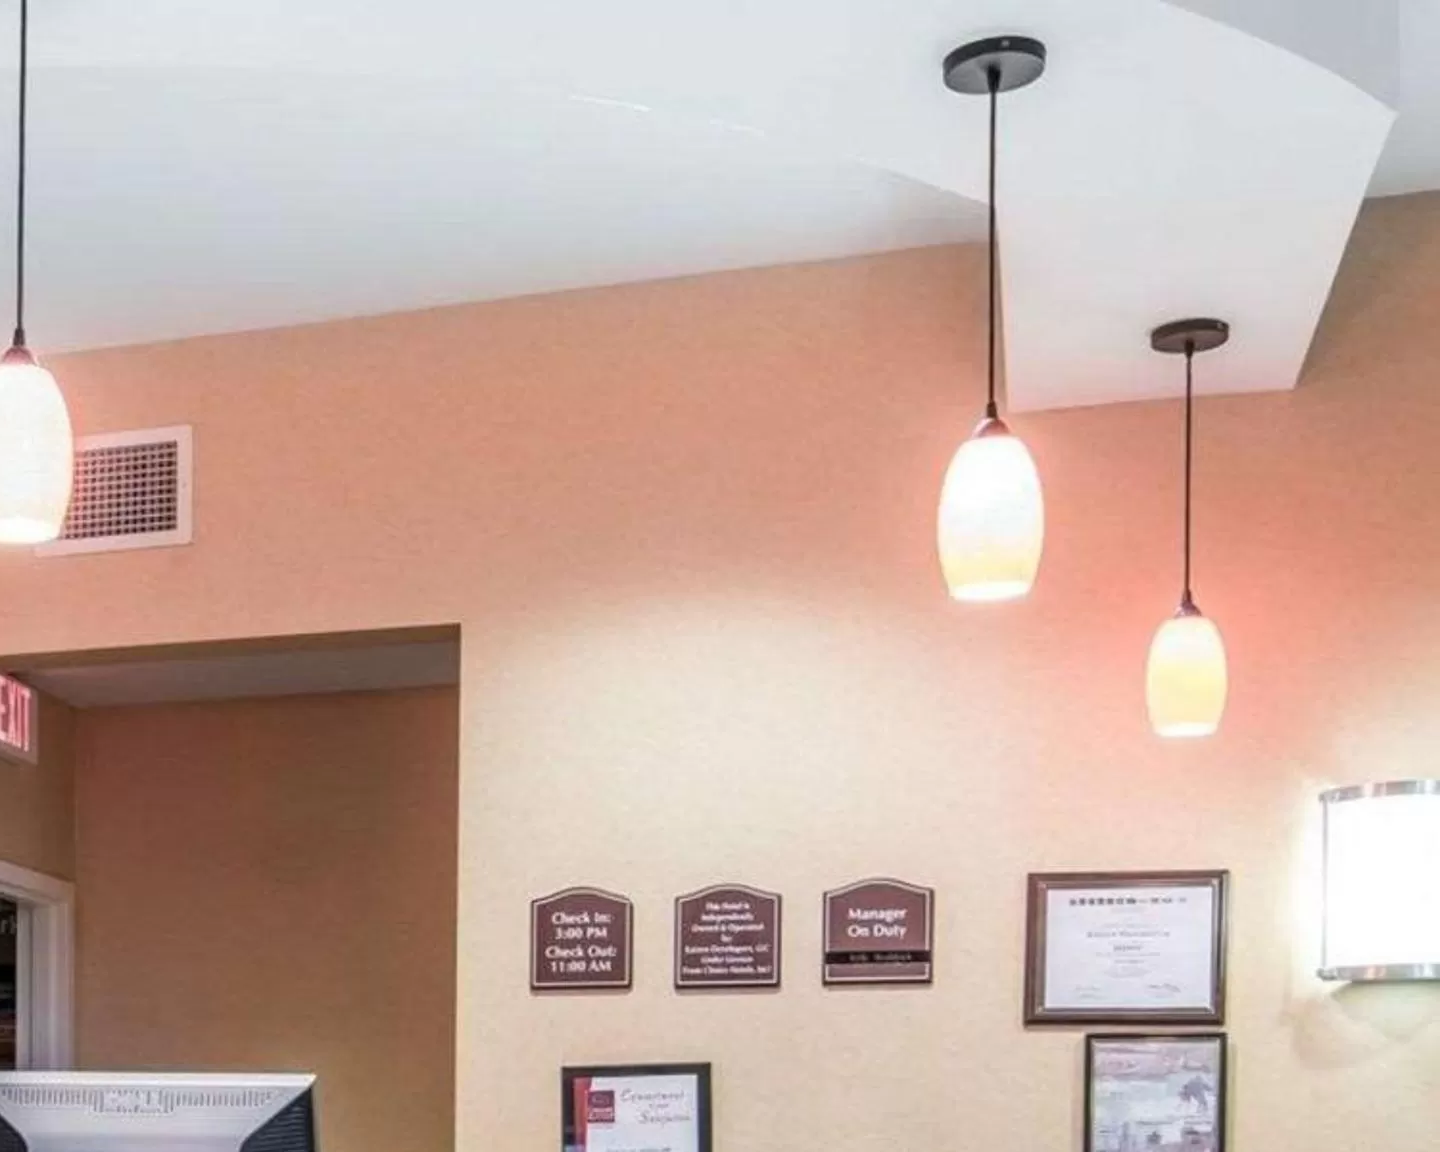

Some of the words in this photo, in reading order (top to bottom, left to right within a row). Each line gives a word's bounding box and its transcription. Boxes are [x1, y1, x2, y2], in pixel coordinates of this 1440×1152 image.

[551, 911, 590, 925] Check
[847, 906, 908, 923] Manager
[586, 926, 608, 939] PM
[847, 924, 870, 938] On
[872, 923, 908, 940] Duty
[544, 944, 585, 959] Check
[550, 960, 587, 973] 11:00
[587, 959, 613, 973] AM
